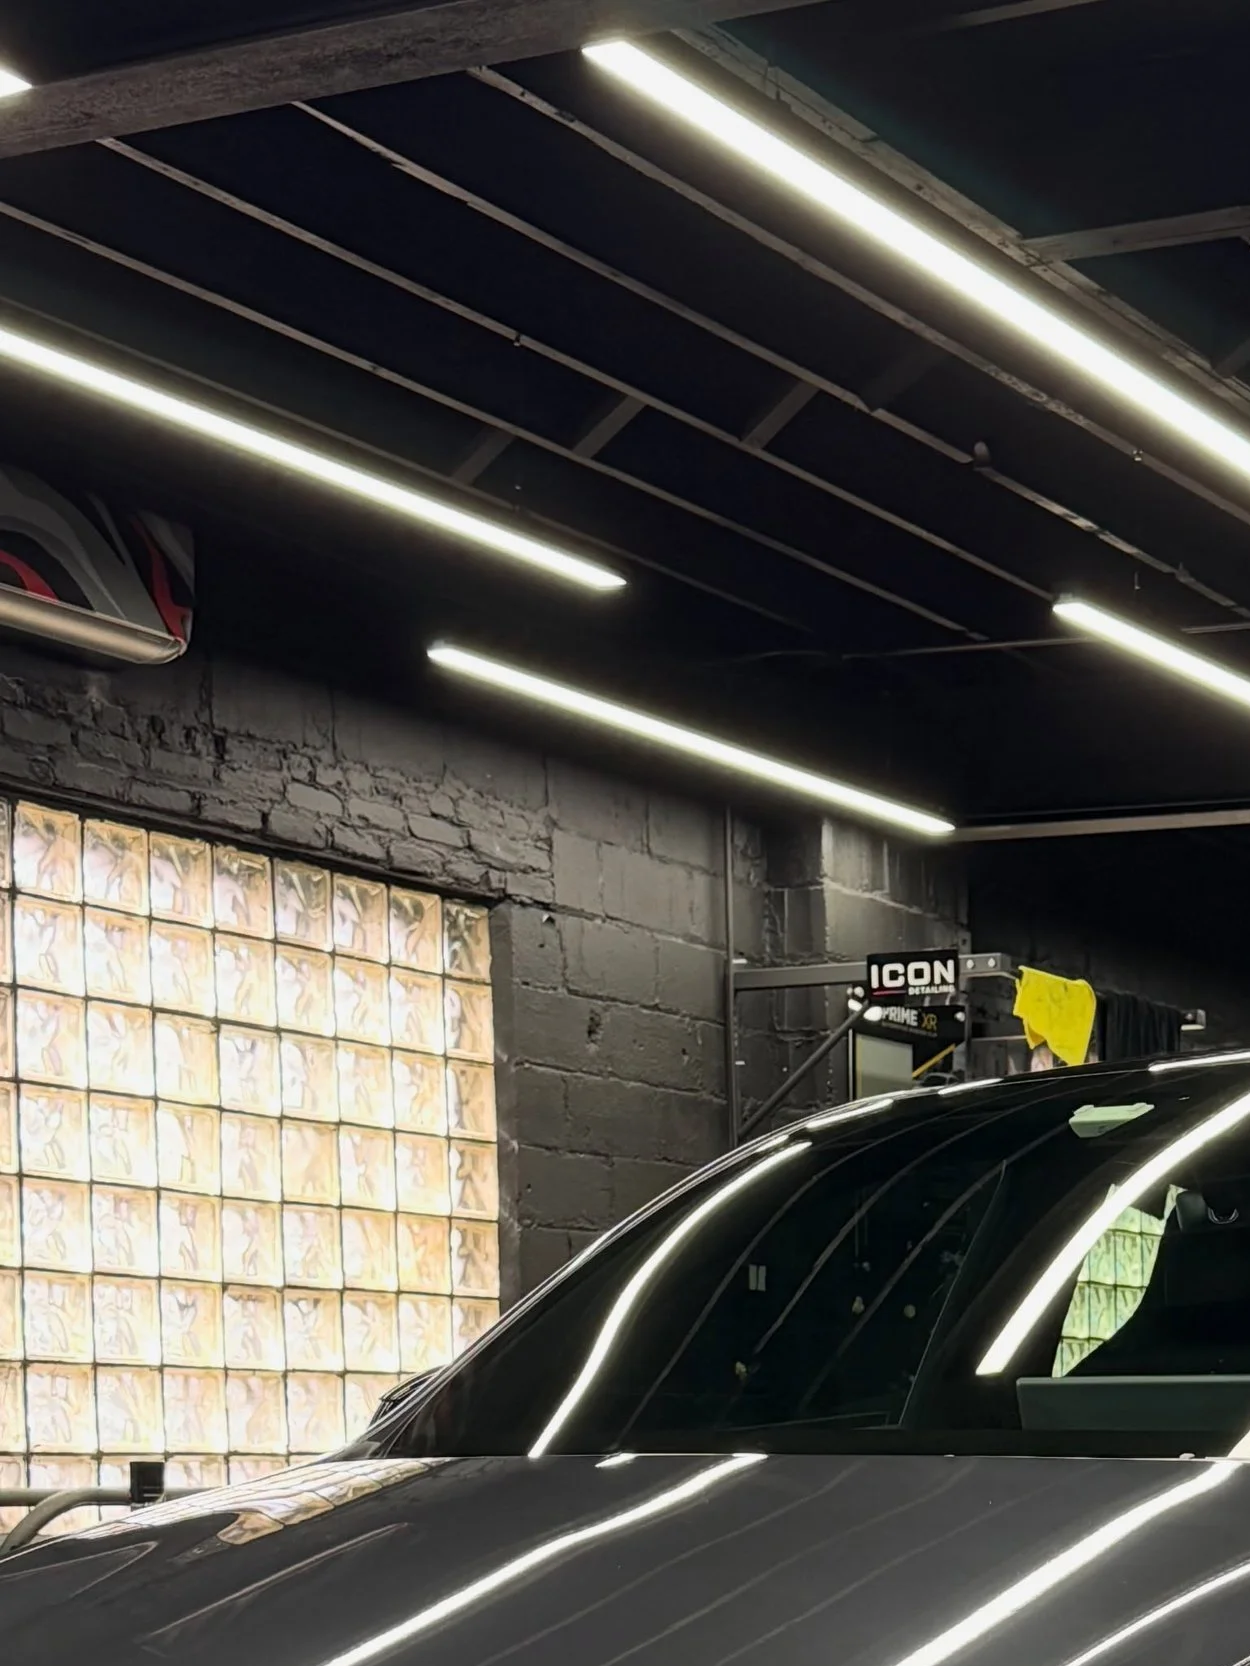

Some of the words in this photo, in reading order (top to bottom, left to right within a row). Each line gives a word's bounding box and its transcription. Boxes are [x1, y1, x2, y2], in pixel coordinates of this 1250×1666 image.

[870, 959, 955, 989] ICON
[907, 985, 955, 996] DETAILING
[881, 1006, 919, 1027] PRIME
[920, 1012, 938, 1031] XR
